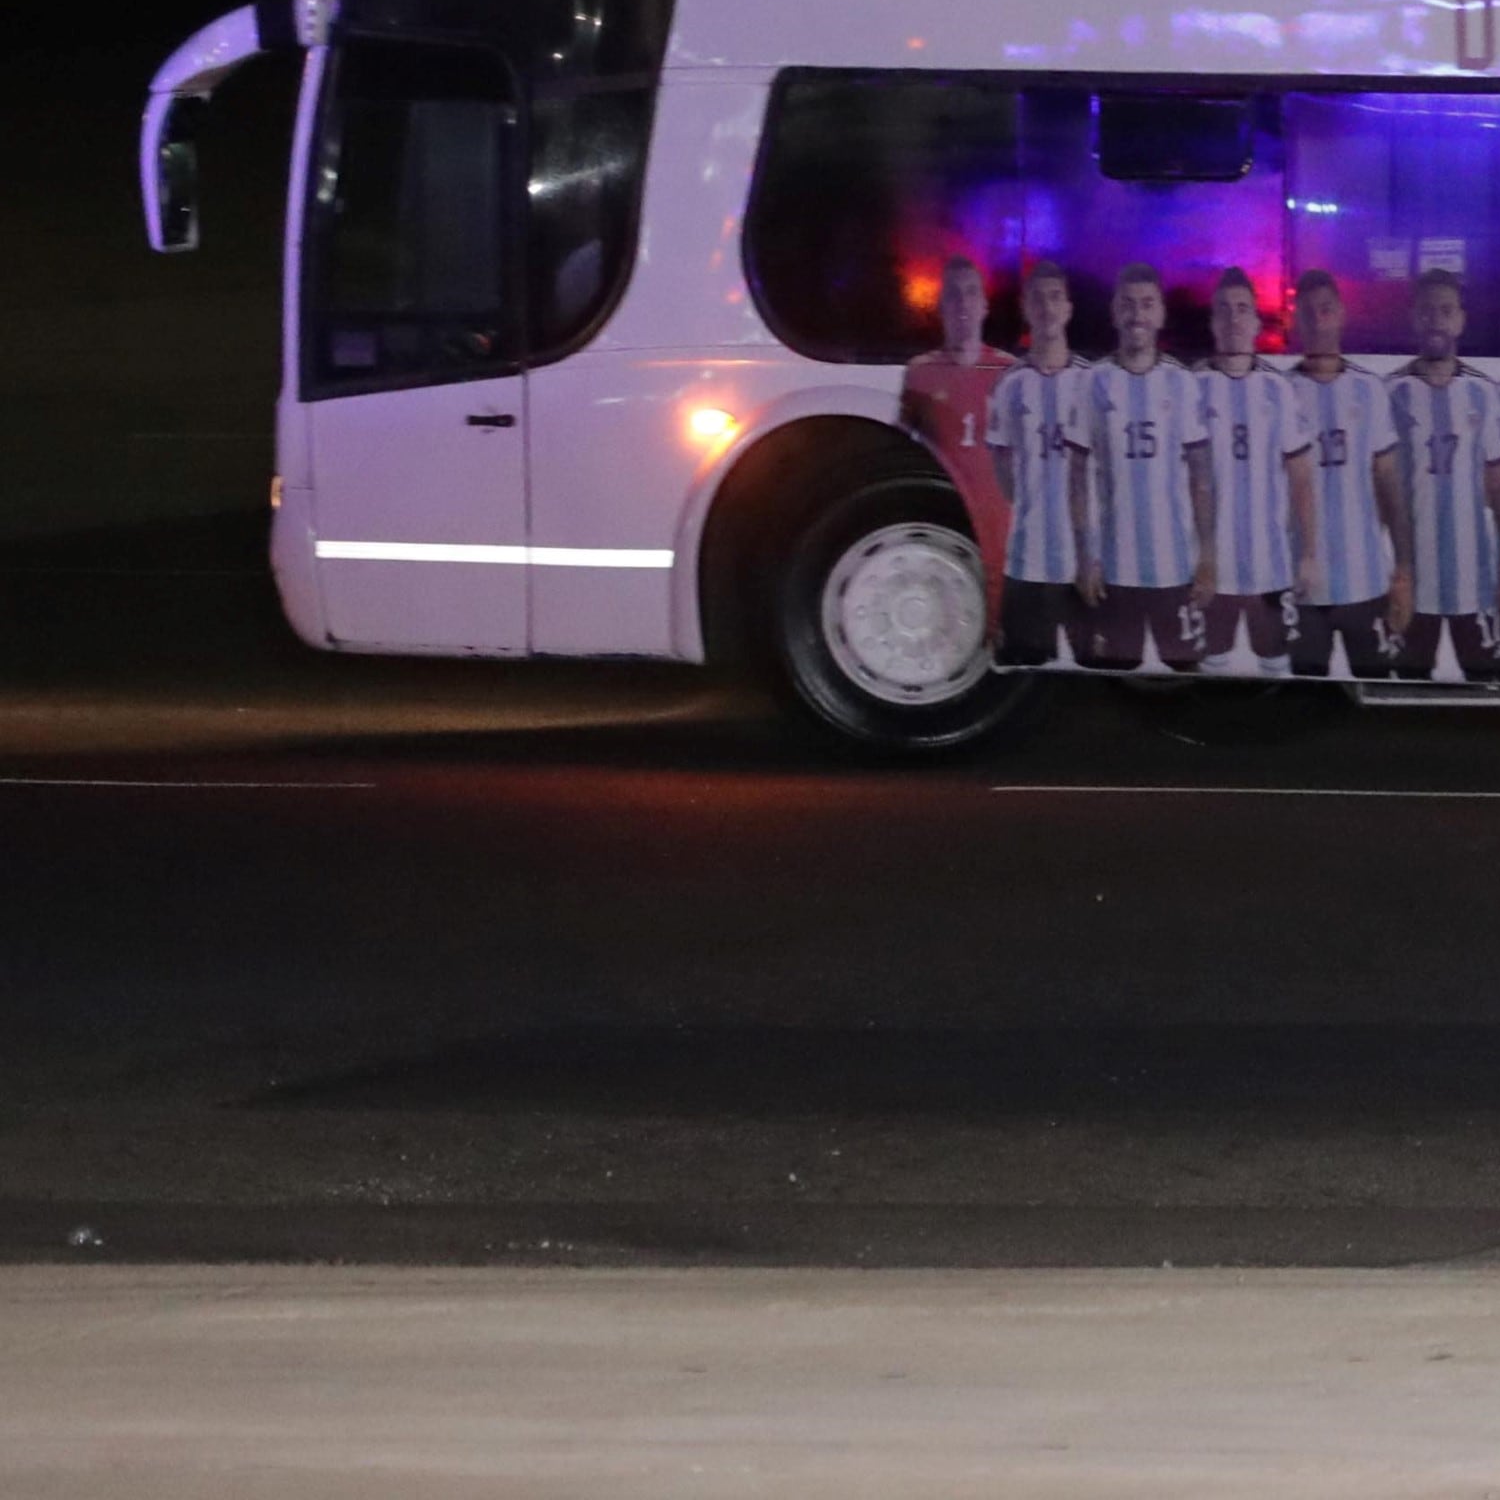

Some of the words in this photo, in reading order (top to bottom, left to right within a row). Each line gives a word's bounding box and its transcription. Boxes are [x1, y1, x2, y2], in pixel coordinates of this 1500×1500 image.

[960, 411, 977, 448] 1
[1124, 420, 1159, 460] 15
[1232, 423, 1250, 461] 8
